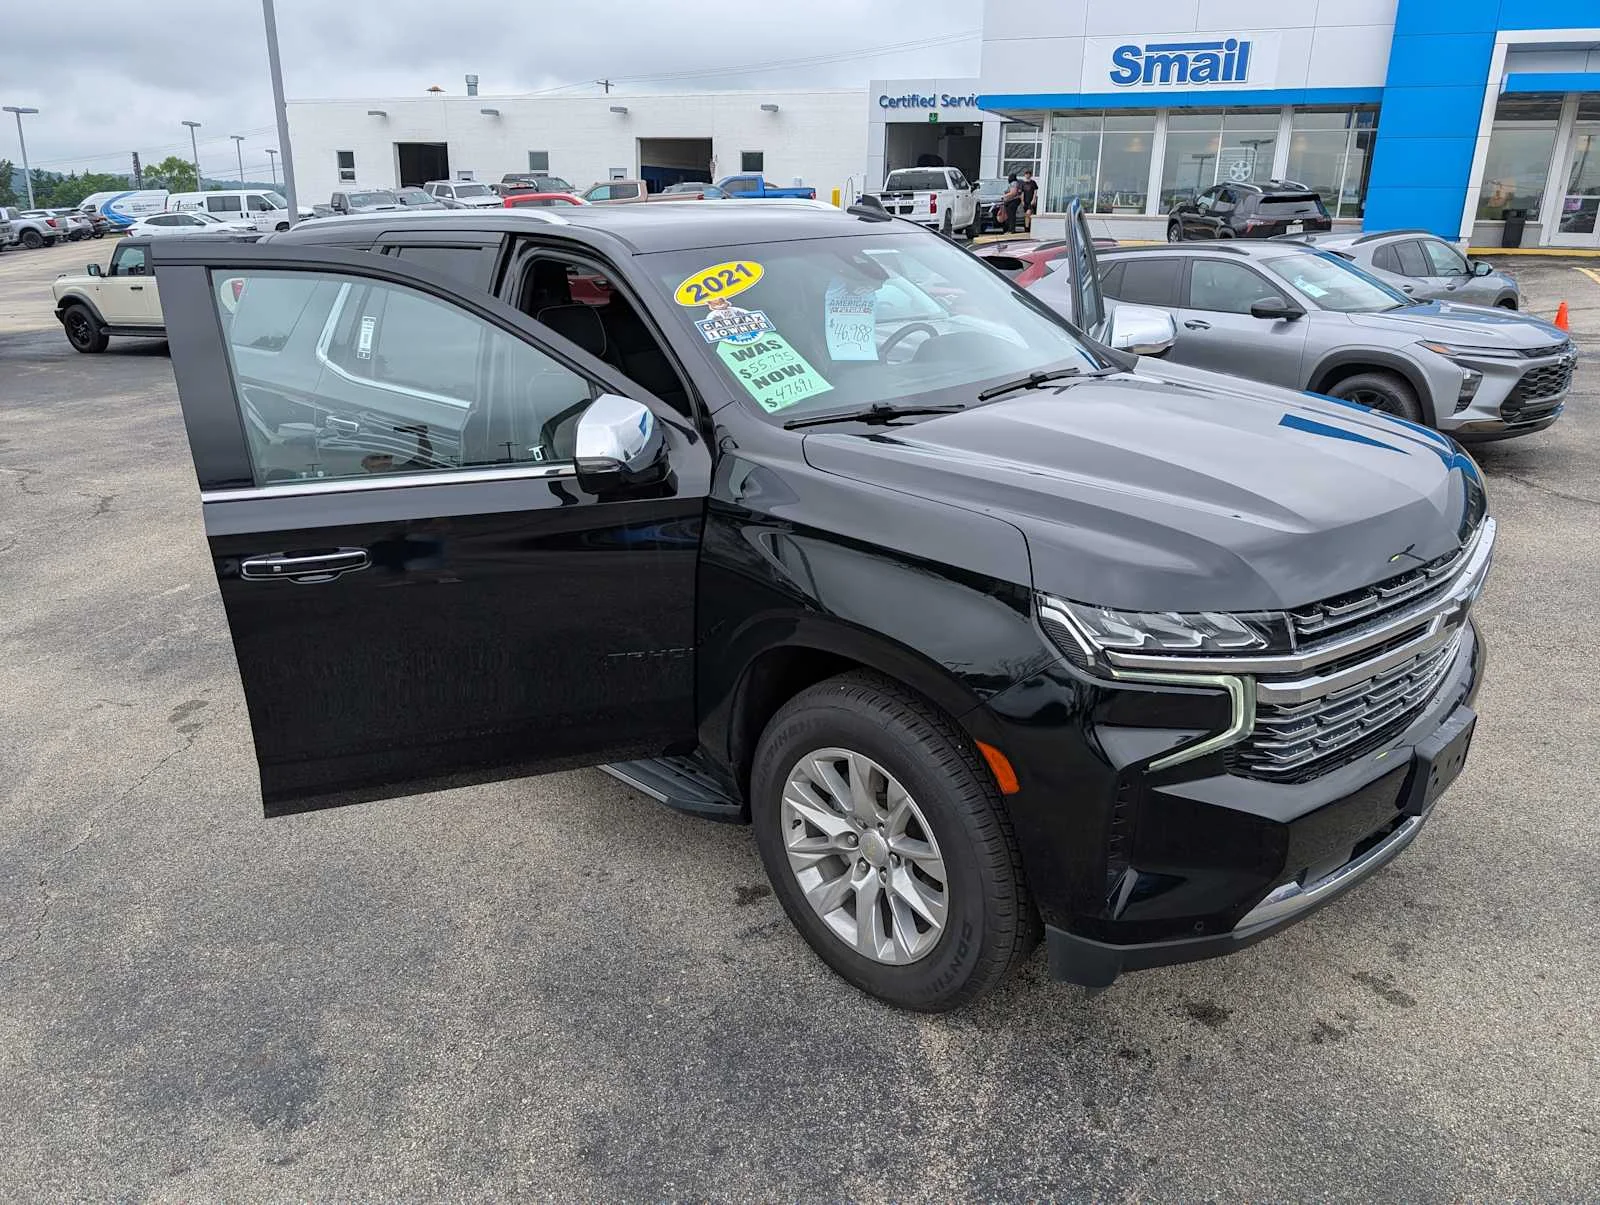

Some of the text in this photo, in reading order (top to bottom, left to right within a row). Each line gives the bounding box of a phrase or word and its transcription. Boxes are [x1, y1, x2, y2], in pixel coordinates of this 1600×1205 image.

[1109, 38, 1251, 85] Smail
[879, 93, 936, 108] Certified
[686, 263, 753, 302] 2021
[703, 315, 764, 331] CARFAX
[730, 339, 783, 363] WAS
[751, 363, 806, 390] NOW
